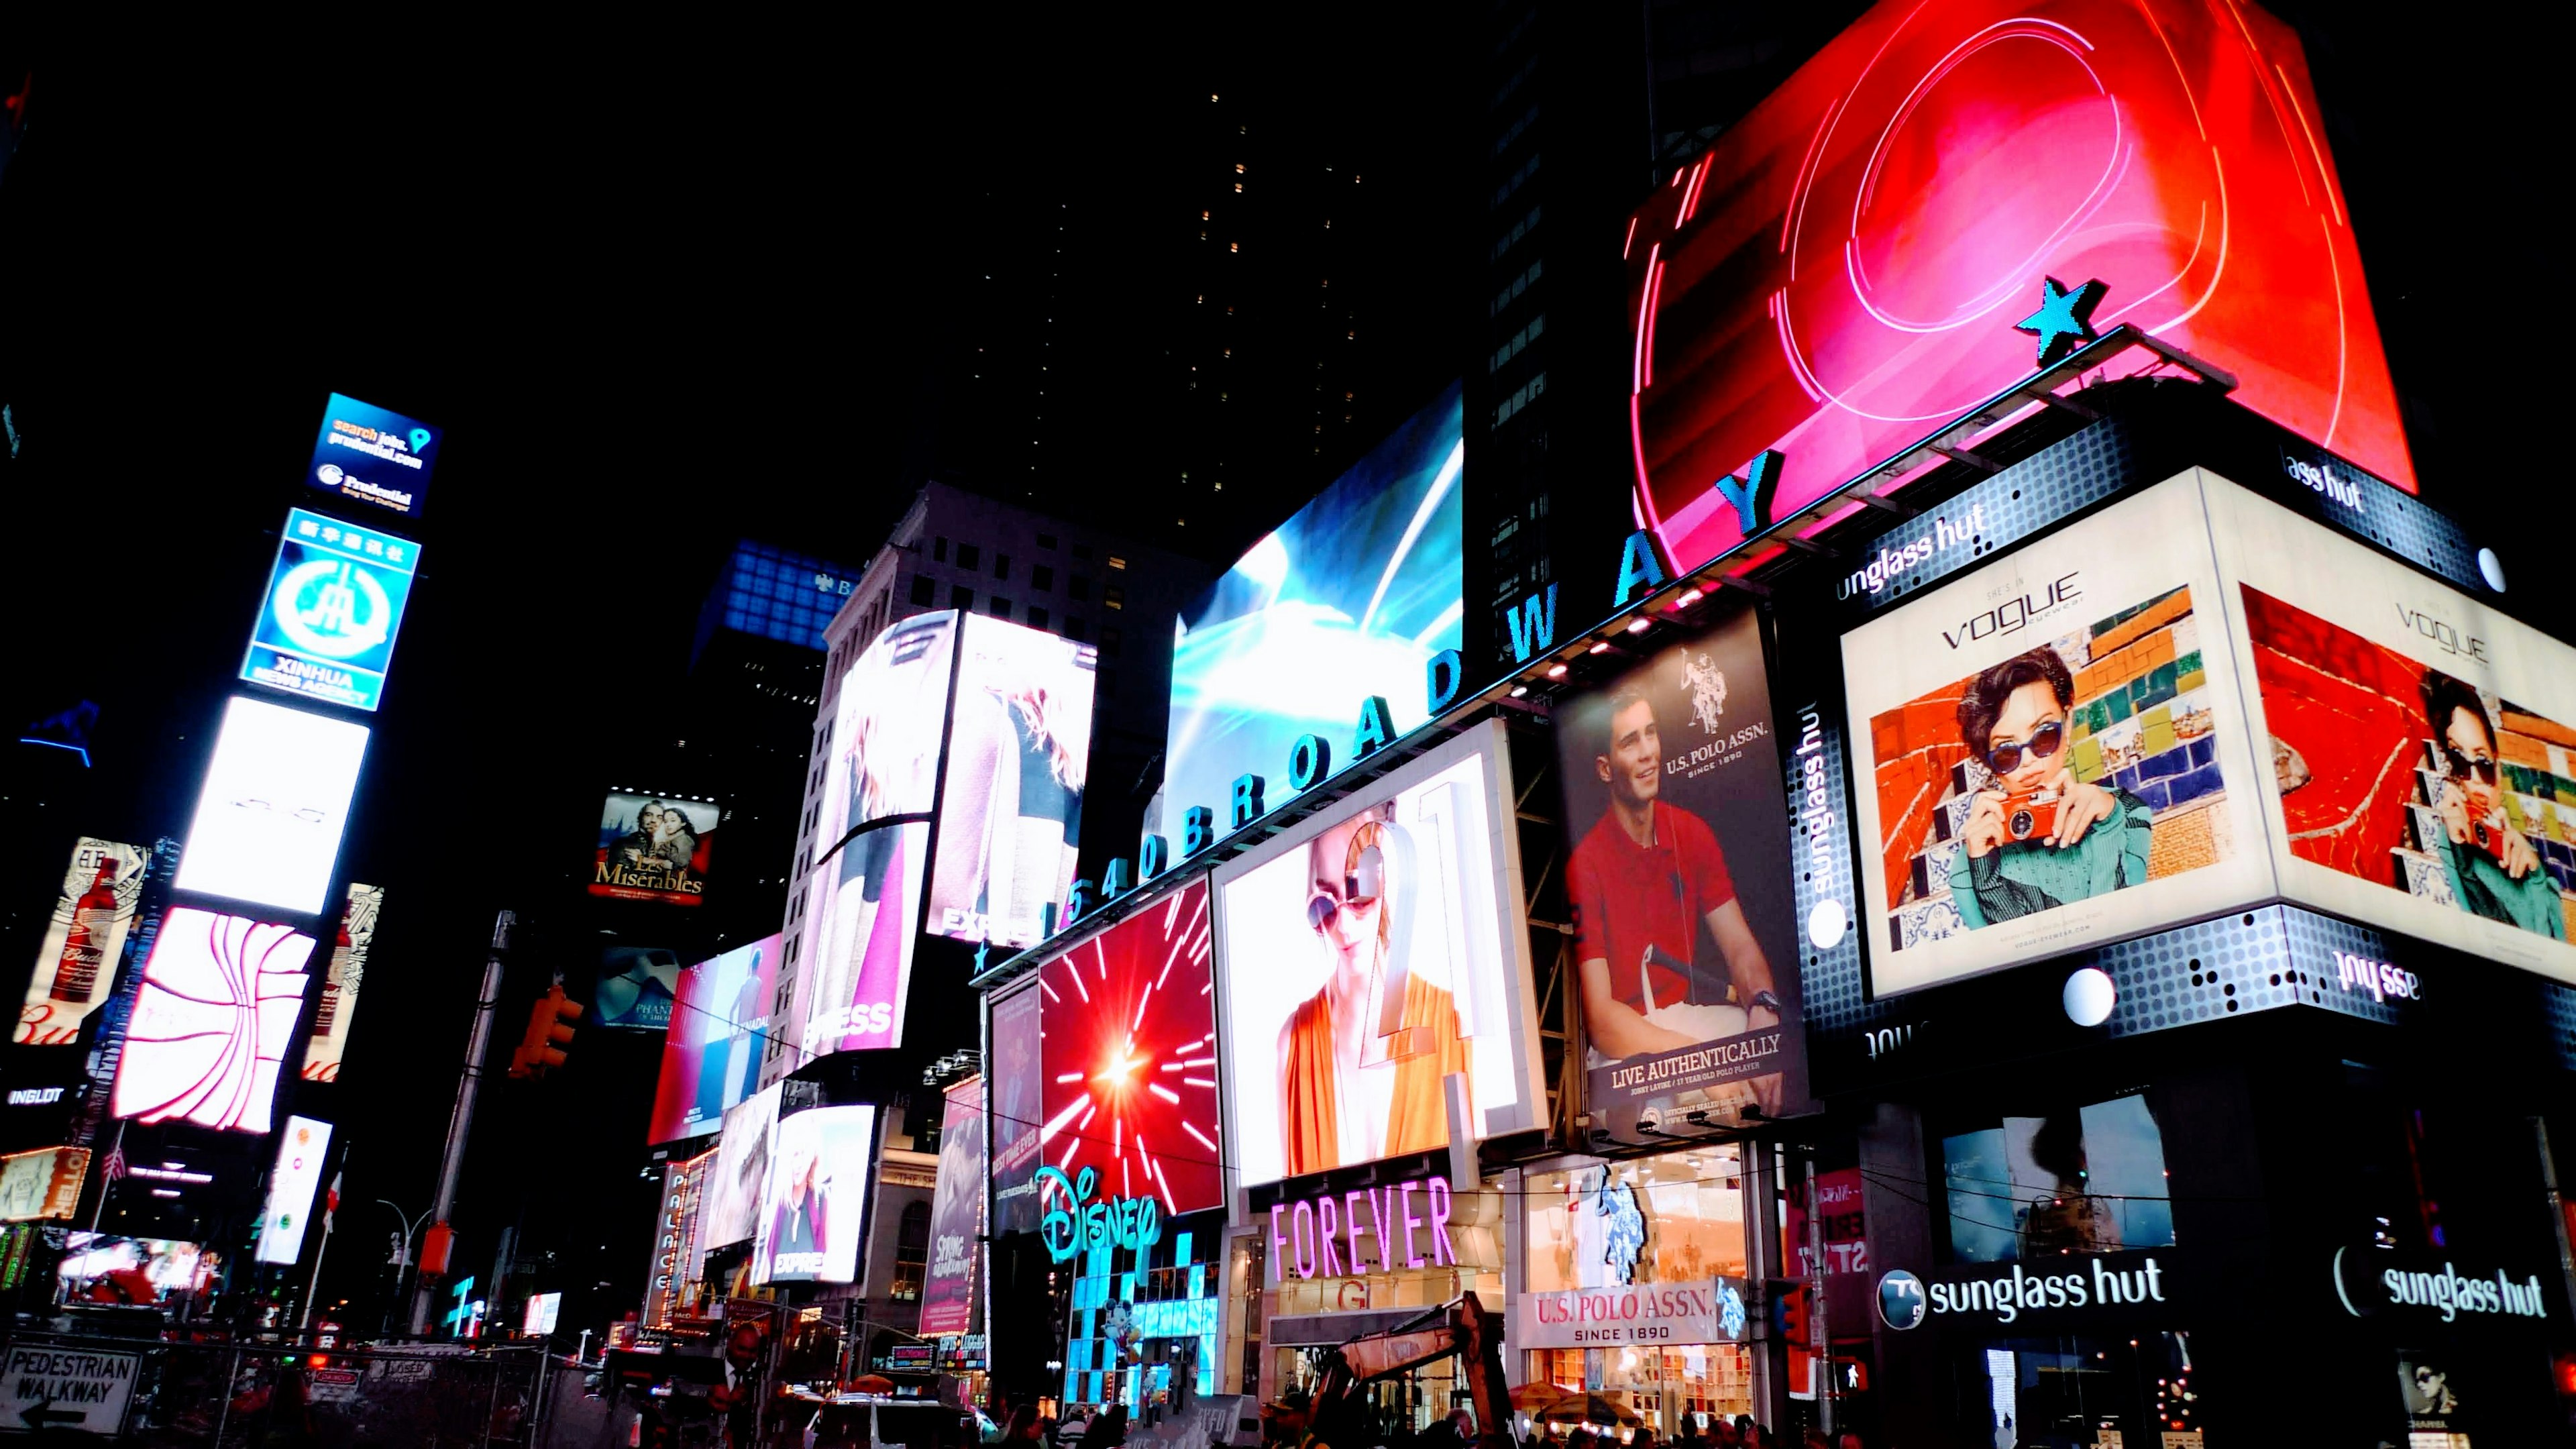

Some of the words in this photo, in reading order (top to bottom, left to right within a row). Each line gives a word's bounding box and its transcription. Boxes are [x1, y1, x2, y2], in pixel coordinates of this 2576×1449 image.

[327, 432, 423, 470] prudential.com
[333, 419, 378, 441] search
[377, 431, 408, 451] jobs.
[343, 474, 412, 505] Prudential
[2322, 466, 2364, 513] hut
[1937, 504, 1987, 551] hut
[276, 655, 353, 688] XINHUA
[1183, 449, 1786, 859] BROADWAY
[254, 666, 302, 690] NEWS
[300, 678, 370, 706] AGENCY
[1666, 756, 1690, 774] U.S.
[1690, 739, 1725, 765] POLO
[1729, 722, 1768, 749] ASSN.
[1688, 762, 1715, 778] SINCE
[1801, 755, 1835, 894] sunglass
[595, 861, 702, 894] Misérables
[634, 855, 663, 873] Les
[2332, 951, 2383, 1003] hut
[1612, 1065, 1645, 1089] LIVE
[1648, 1034, 1780, 1080] AUTHENTICALLY
[1684, 1076, 1702, 1084] YEAR
[1702, 1073, 1715, 1082] OLD
[1716, 1068, 1733, 1078] POLO
[1735, 1062, 1760, 1074] PLAYER
[7, 1088, 65, 1105] INGLOT
[654, 1174, 684, 1289] PALACE
[1271, 1176, 1457, 1282] FOREVER
[1537, 1299, 1573, 1324] U.S.
[1579, 1293, 1639, 1322] POLO
[1645, 1289, 1714, 1319] ASSN.
[1930, 1264, 2088, 1324] sunglass
[2092, 1258, 2165, 1305] hut
[2384, 1261, 2501, 1323] sunglass
[2498, 1268, 2547, 1318] hut
[961, 1334, 985, 1350] LUGGAG
[1574, 1328, 1621, 1341] SINCE
[1629, 1326, 1669, 1339] 1890
[11, 1352, 130, 1380] PEDESTRIAN
[15, 1377, 113, 1403] WALKWAY
